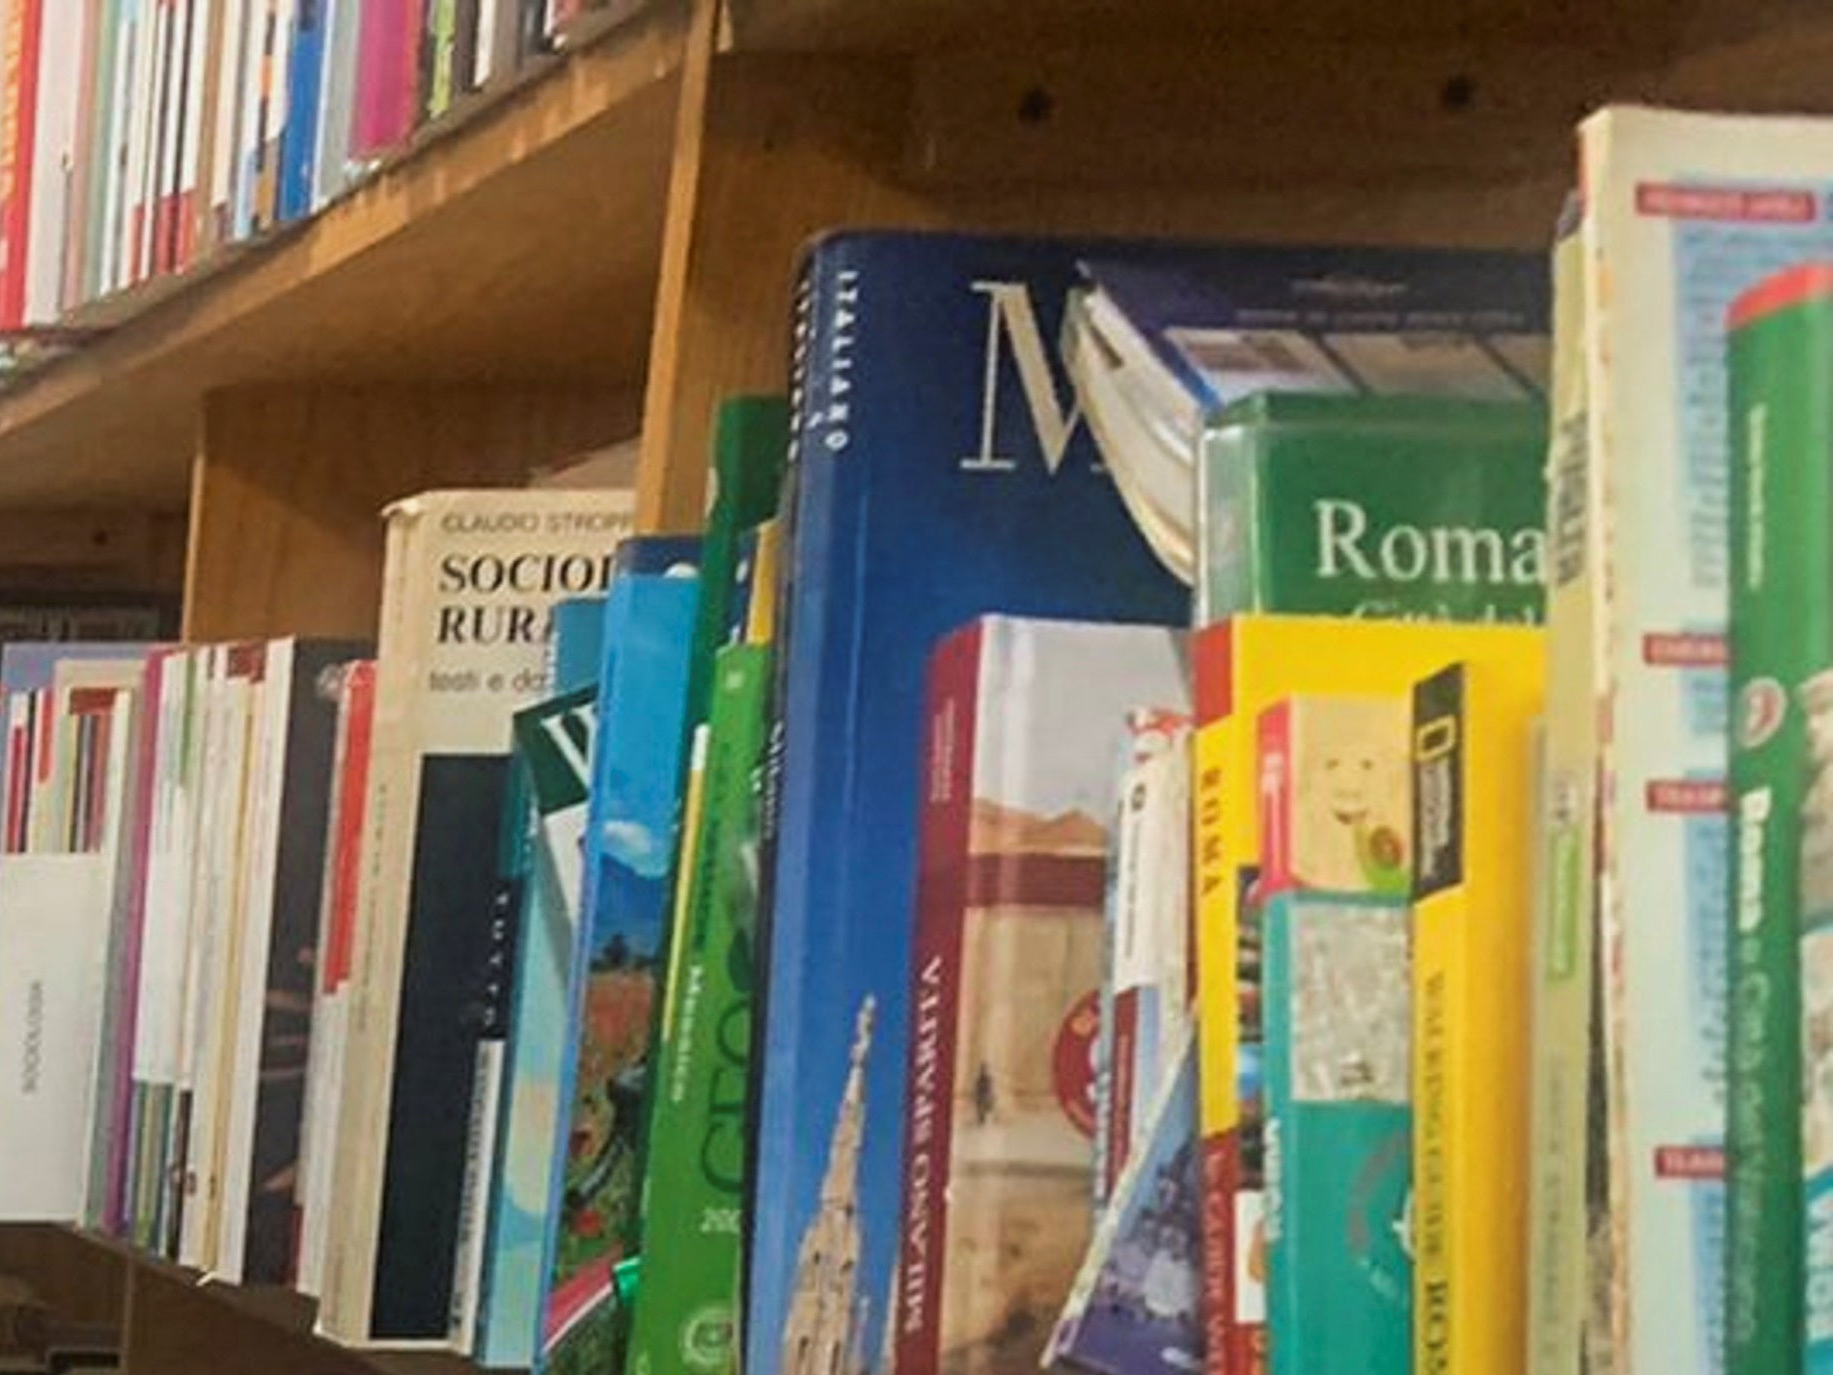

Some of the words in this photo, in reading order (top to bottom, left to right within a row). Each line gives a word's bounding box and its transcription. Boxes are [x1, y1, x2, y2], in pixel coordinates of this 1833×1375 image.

[1314, 498, 1547, 584] Roma
[438, 606, 553, 643] RUR
[1201, 767, 1221, 898] ROMA
[910, 959, 941, 1166] SPARITA
[903, 1173, 933, 1334] MILANO
